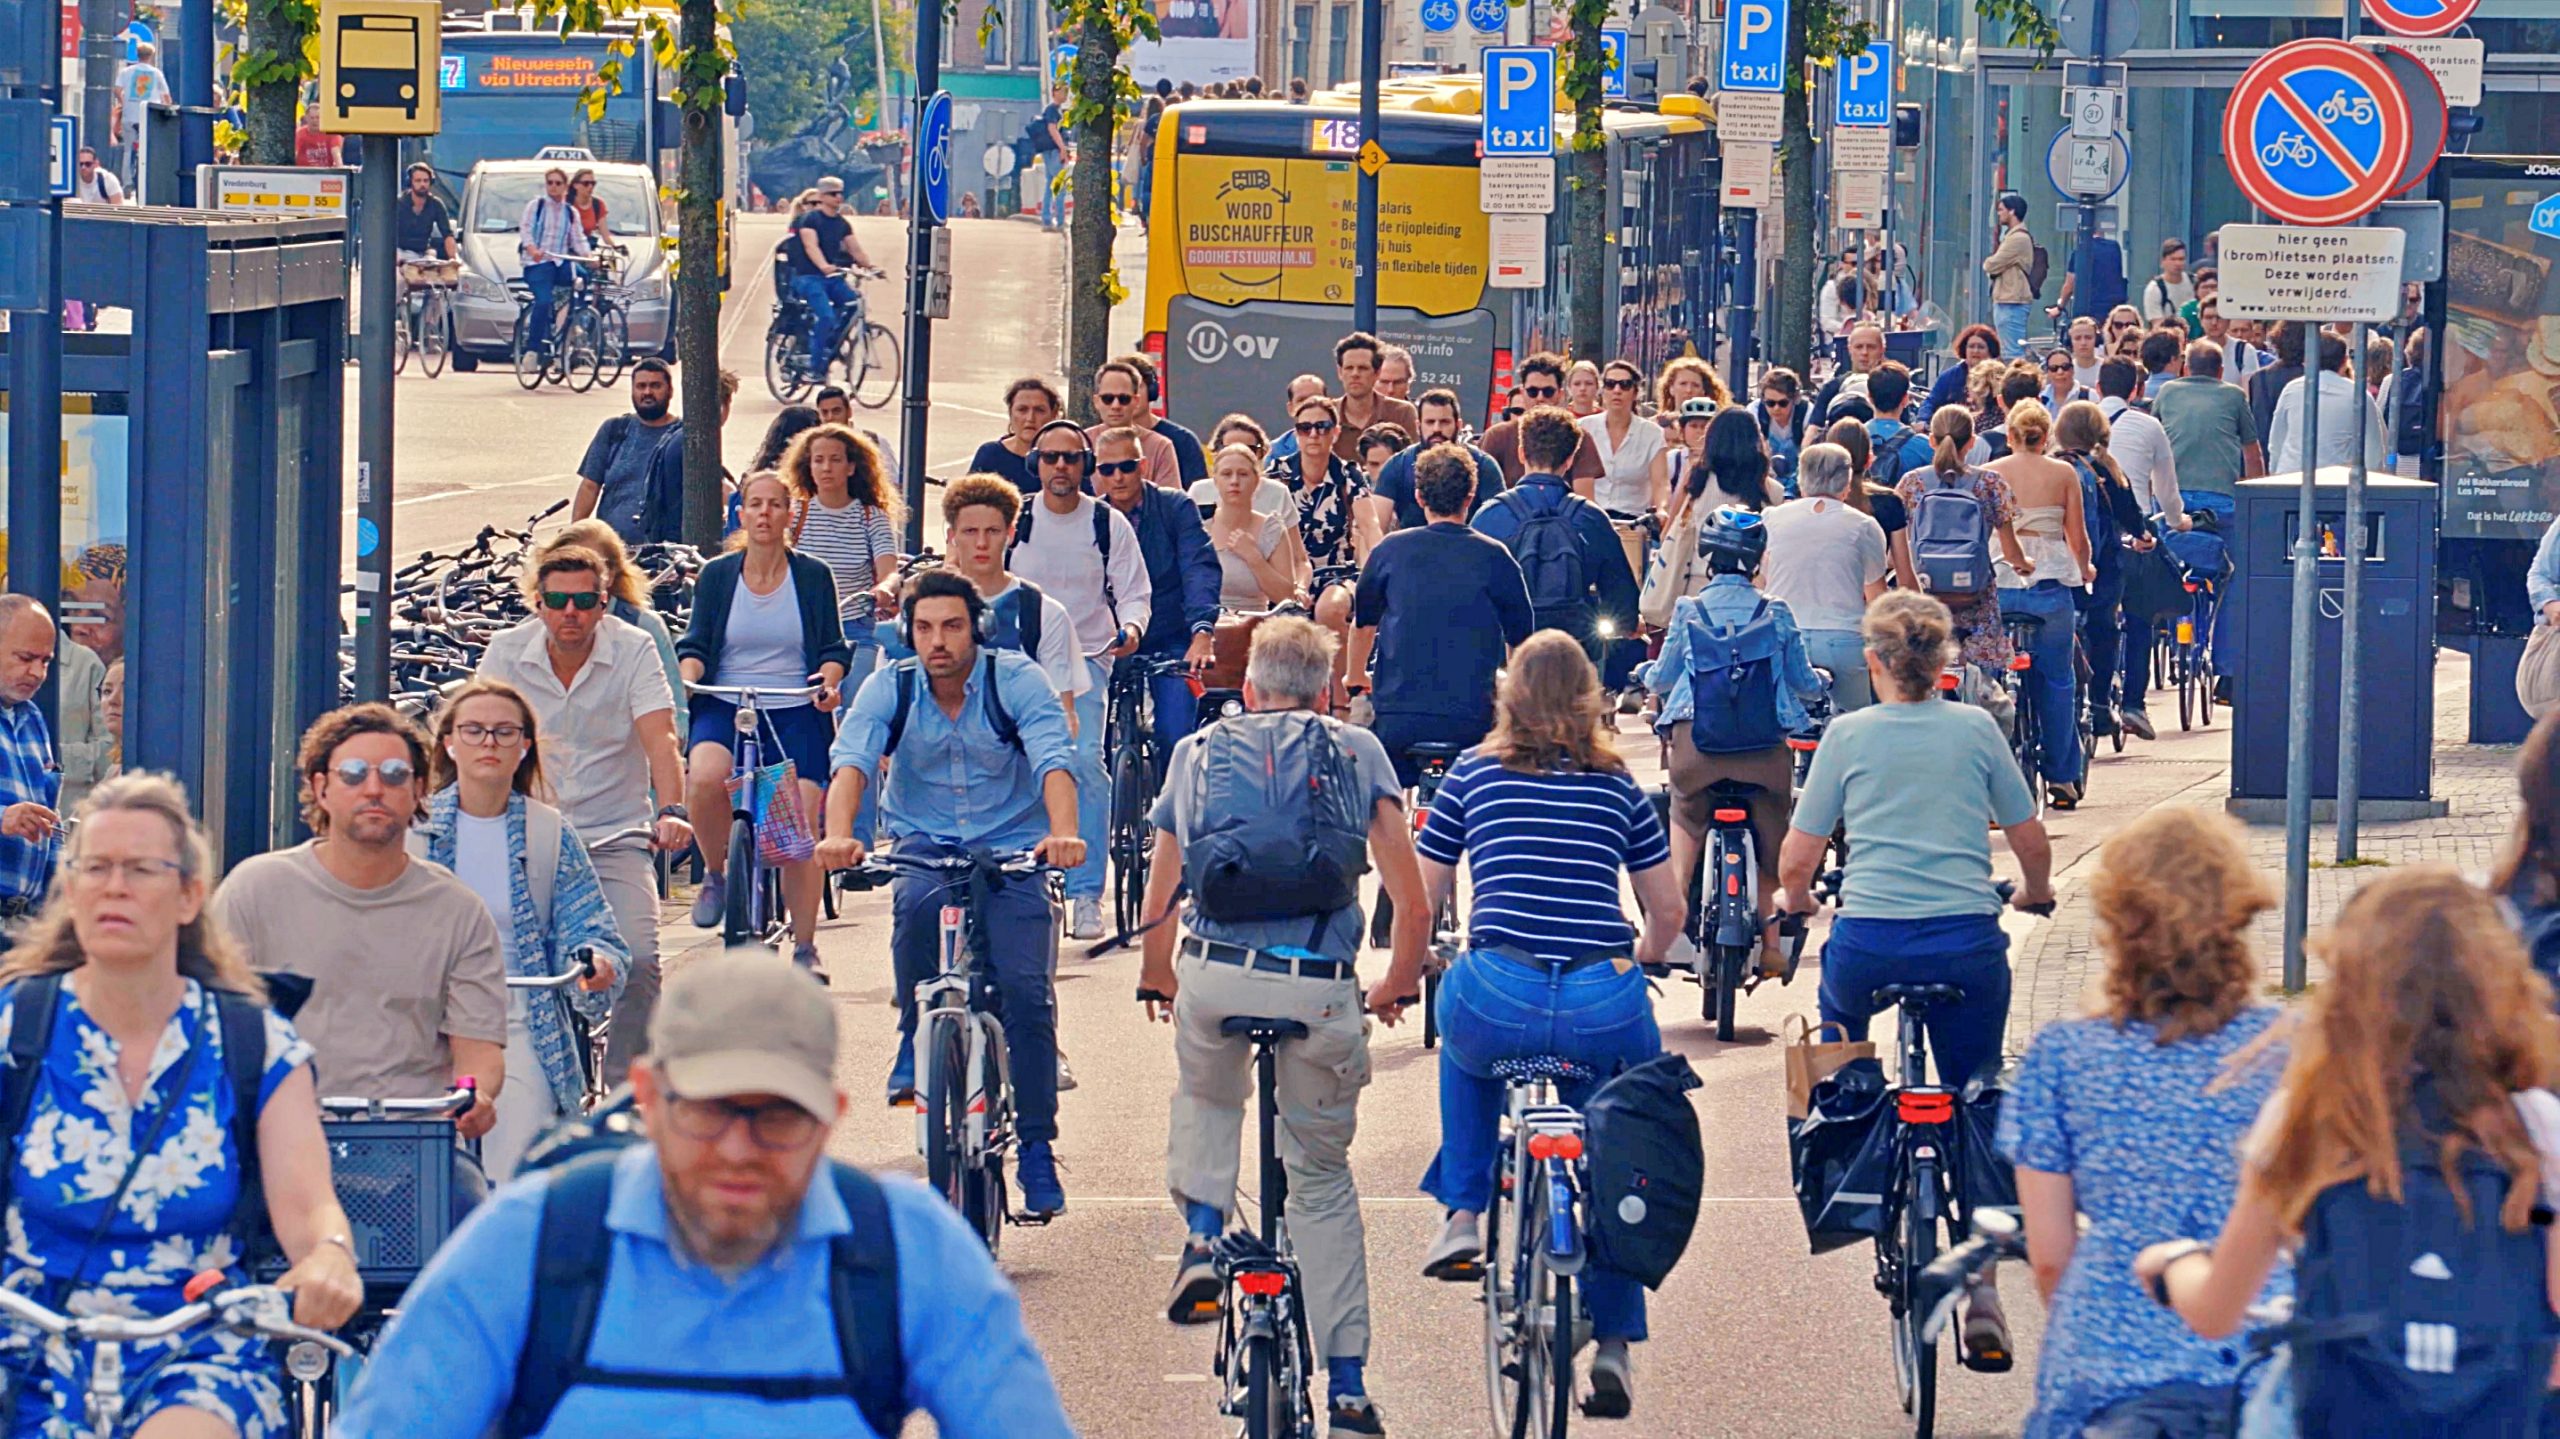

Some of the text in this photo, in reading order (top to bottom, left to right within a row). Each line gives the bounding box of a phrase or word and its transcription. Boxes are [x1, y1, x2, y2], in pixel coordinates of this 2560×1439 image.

[1739, 4, 1772, 50] P
[2430, 57, 2480, 65] plaatsen.
[1731, 61, 1776, 81] taxi
[1850, 50, 1879, 91] P
[480, 74, 510, 87] via
[514, 74, 581, 87] Utrecht
[1499, 57, 1537, 110] P
[1843, 100, 1884, 117] taxi
[2087, 109, 2099, 119] 31
[1323, 120, 1359, 149] 18
[1491, 125, 1545, 147] taxi
[549, 151, 582, 159] TAXI
[1371, 152, 1378, 164] 3
[223, 179, 267, 189] Vredenburg
[223, 193, 328, 206] 2 4 8 55
[1226, 202, 1273, 220] WORD
[1379, 202, 1412, 215] alaris
[1189, 224, 1313, 242] BUSCHAUFFEUR
[1396, 222, 1461, 238] rijopleiding
[1388, 241, 1412, 253] huis
[2278, 234, 2348, 248] hier geen
[1188, 250, 1313, 264] GOOIHETSTUUROM.NL
[2224, 250, 2398, 265] (brom)fietsen plaatsen.
[1393, 260, 1440, 274] flexibele
[1444, 261, 1477, 276] tijden
[2265, 268, 2359, 281] Deze worden
[2268, 287, 2352, 301] verwijderd.
[2240, 305, 2377, 316] www.utrecht.nl/fietsweg
[1233, 334, 1280, 359] OV
[1421, 372, 1461, 385] 52 241
[2457, 478, 2471, 486] AH
[2467, 511, 2482, 520] Dat
[2484, 511, 2492, 520] is
[2493, 511, 2507, 520] het
